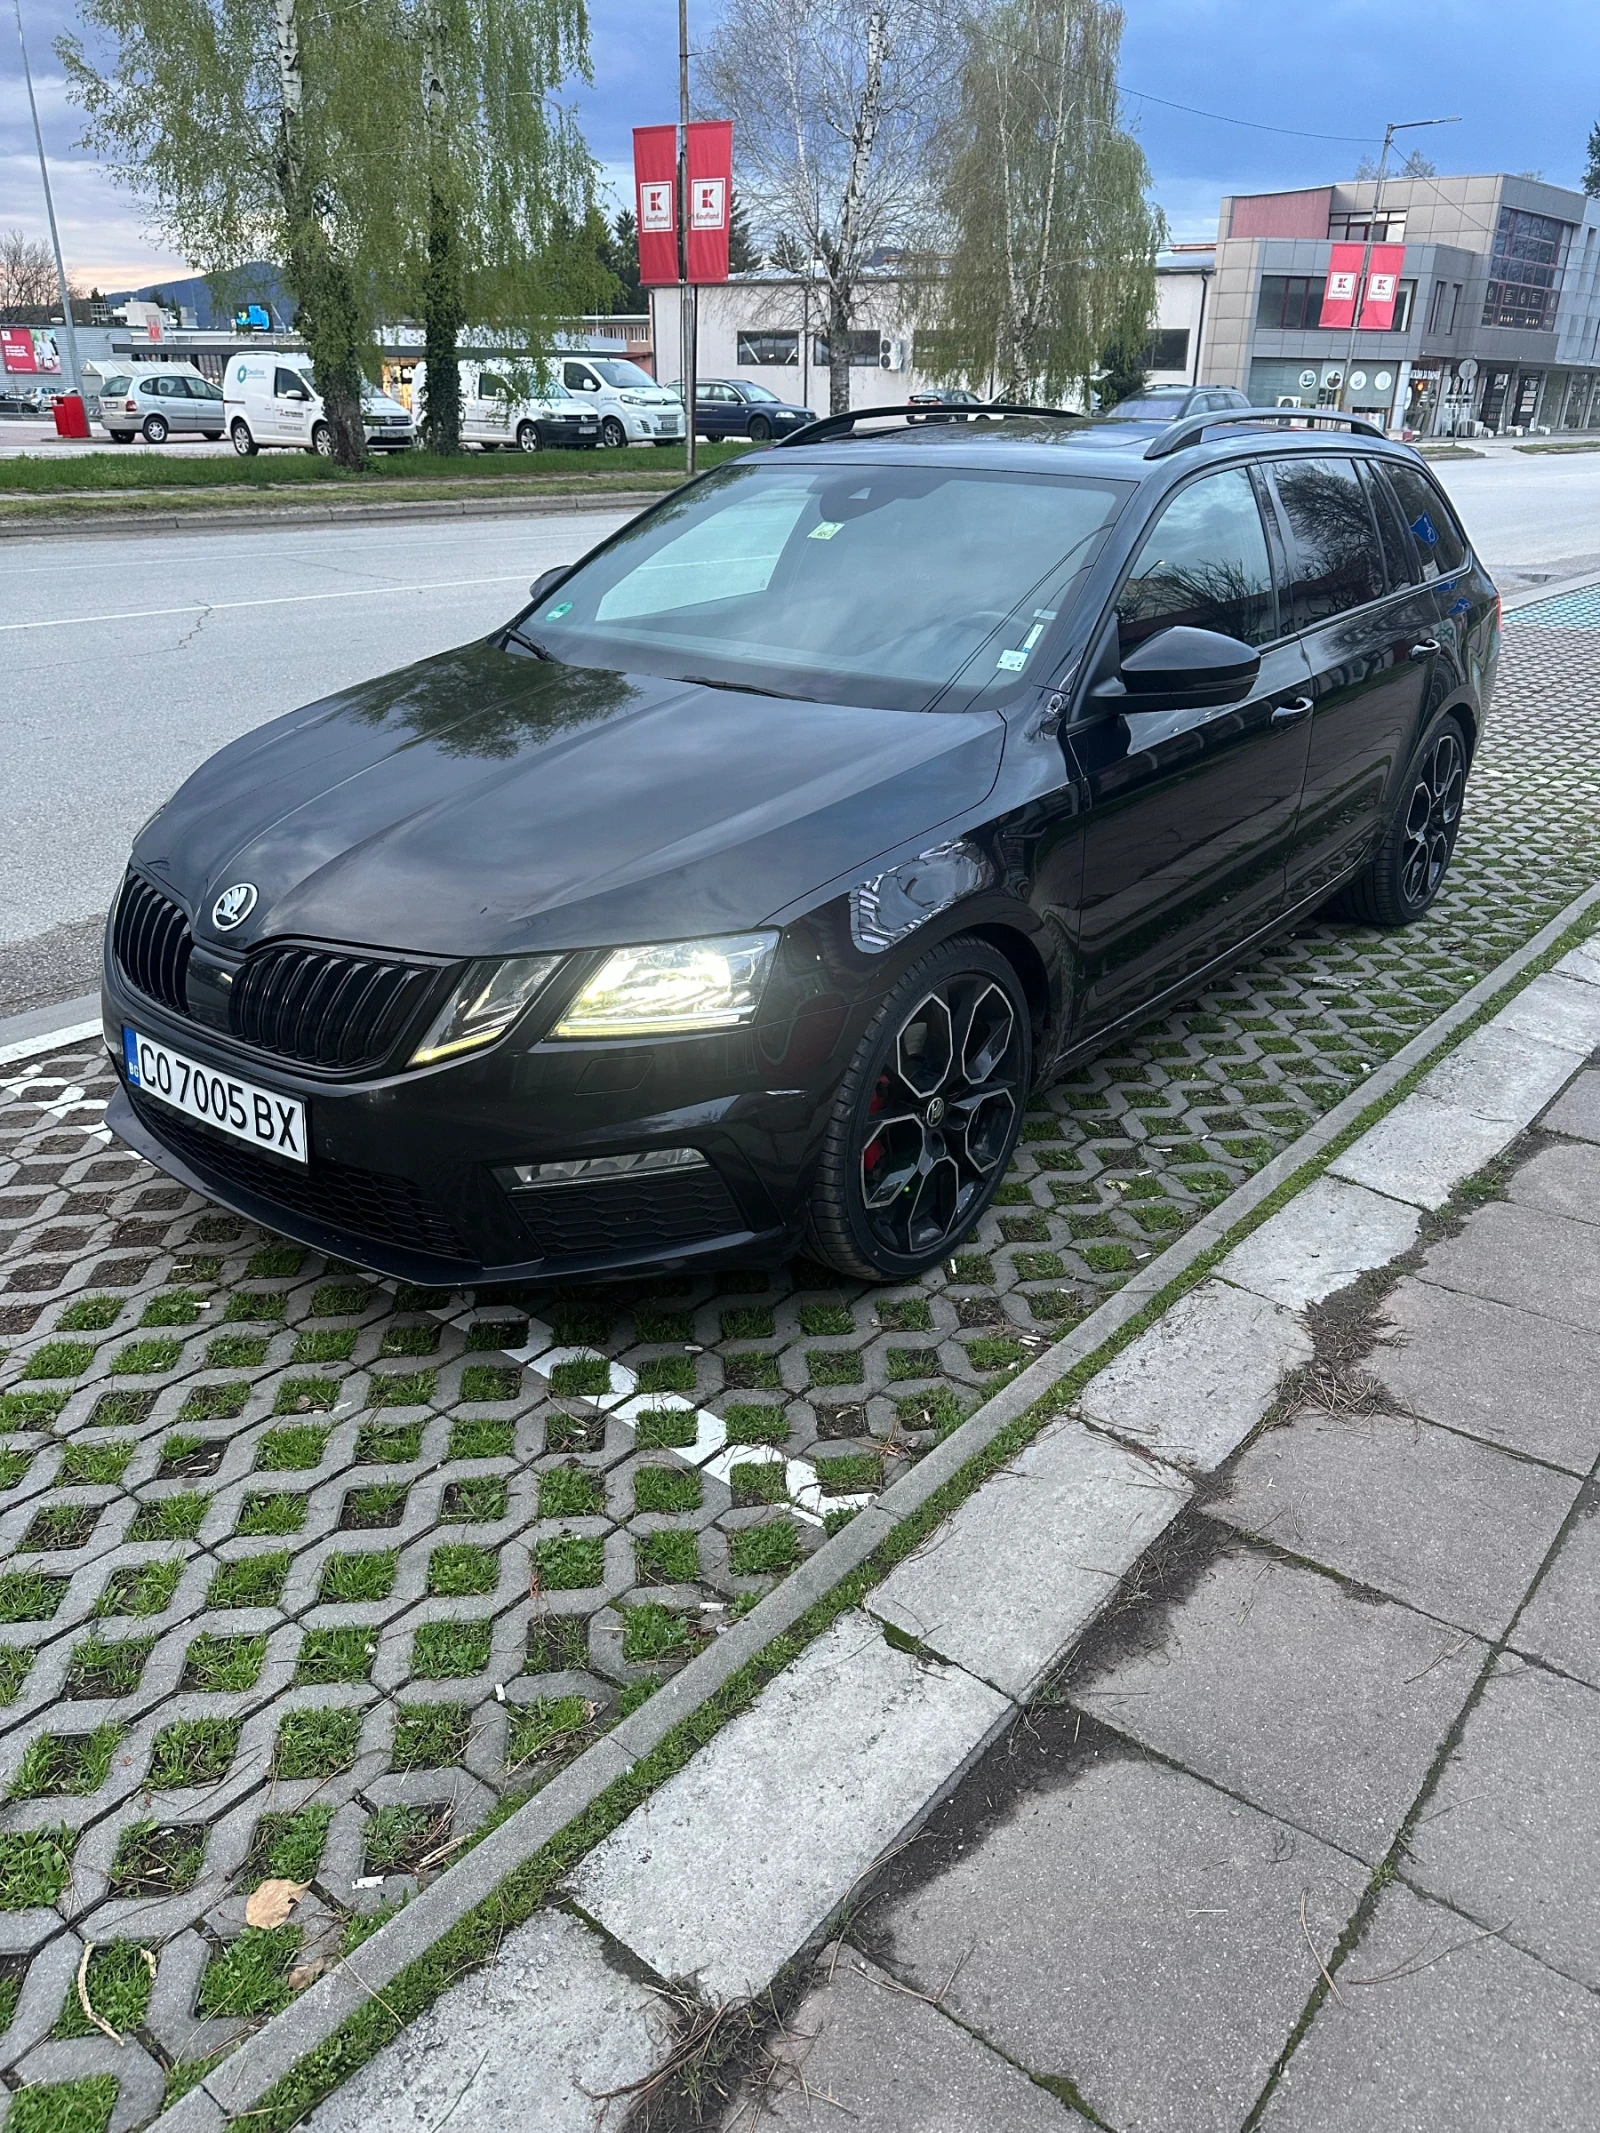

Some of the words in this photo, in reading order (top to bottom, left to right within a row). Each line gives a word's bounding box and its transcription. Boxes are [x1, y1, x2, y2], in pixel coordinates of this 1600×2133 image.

[650, 192, 662, 211] K
[702, 189, 714, 208] K
[696, 212, 719, 220] Kaufland
[129, 1061, 139, 1078] BG
